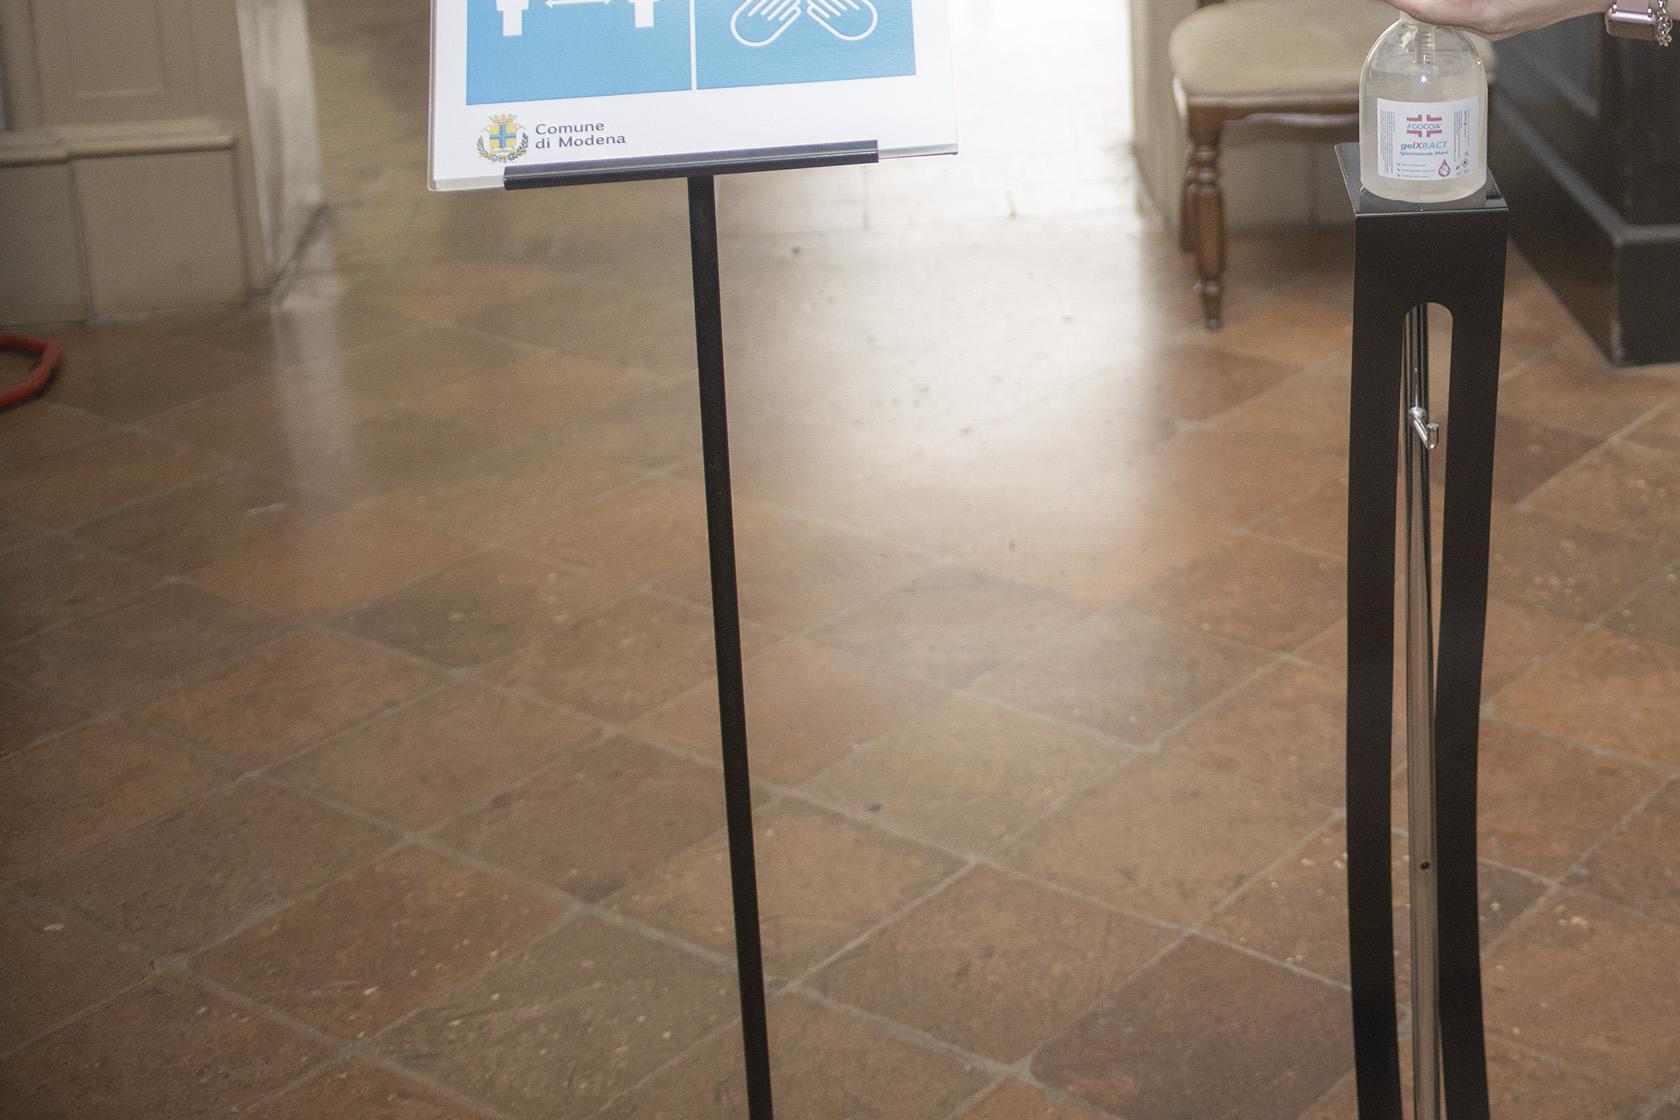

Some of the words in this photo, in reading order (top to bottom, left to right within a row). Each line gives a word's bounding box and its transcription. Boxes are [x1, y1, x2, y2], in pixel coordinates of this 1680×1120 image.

[535, 122, 605, 136] Comune
[535, 137, 551, 150] di
[558, 134, 626, 148] Modena
